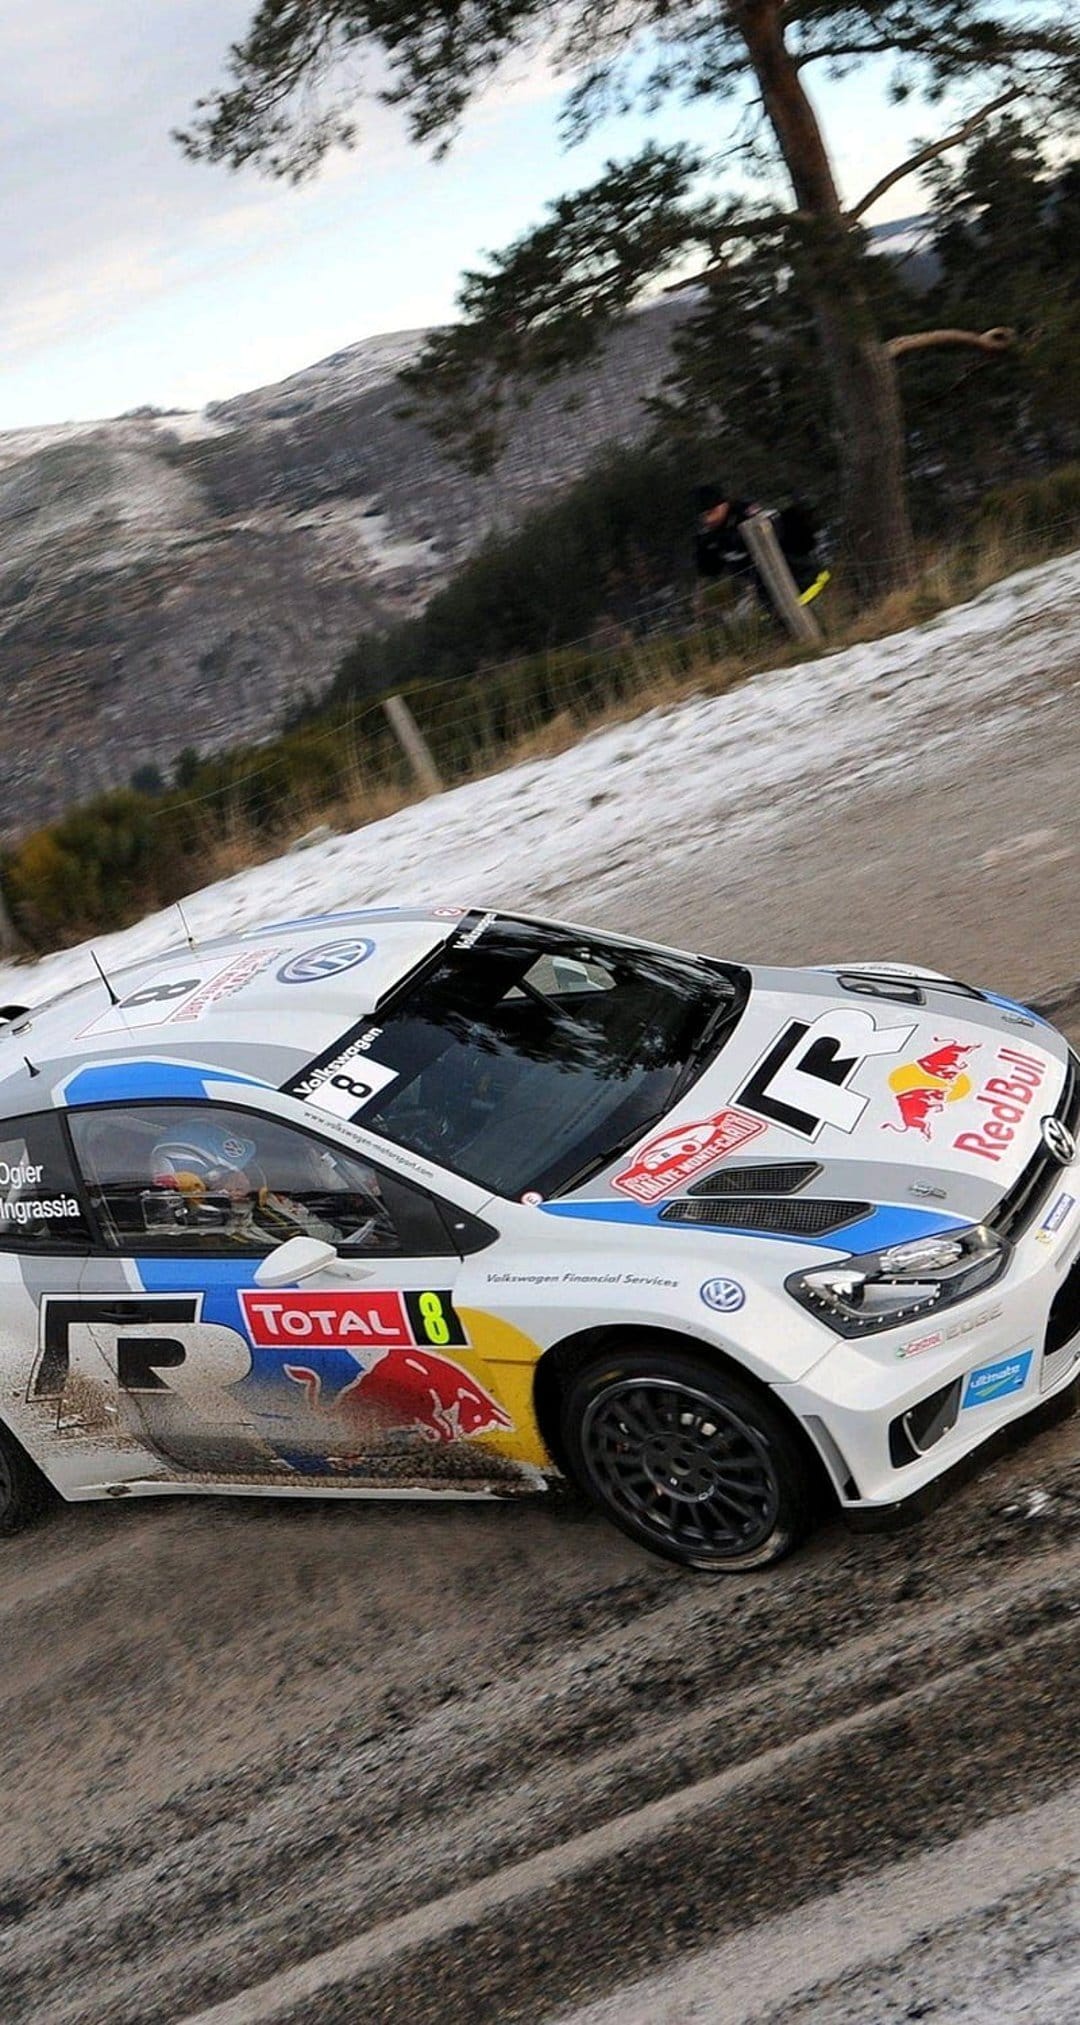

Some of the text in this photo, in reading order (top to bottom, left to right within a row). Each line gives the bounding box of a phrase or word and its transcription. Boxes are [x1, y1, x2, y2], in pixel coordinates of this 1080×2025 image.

[119, 978, 201, 1009] 8
[292, 1026, 385, 1096] Volkswagen
[330, 1073, 373, 1098] 8
[0, 1161, 44, 1189] Ogier
[631, 1166, 686, 1198] RALLYE
[486, 1272, 679, 1288] Volkswagen Financial Services
[251, 1303, 400, 1336] TOTAL
[418, 1291, 450, 1345] 8
